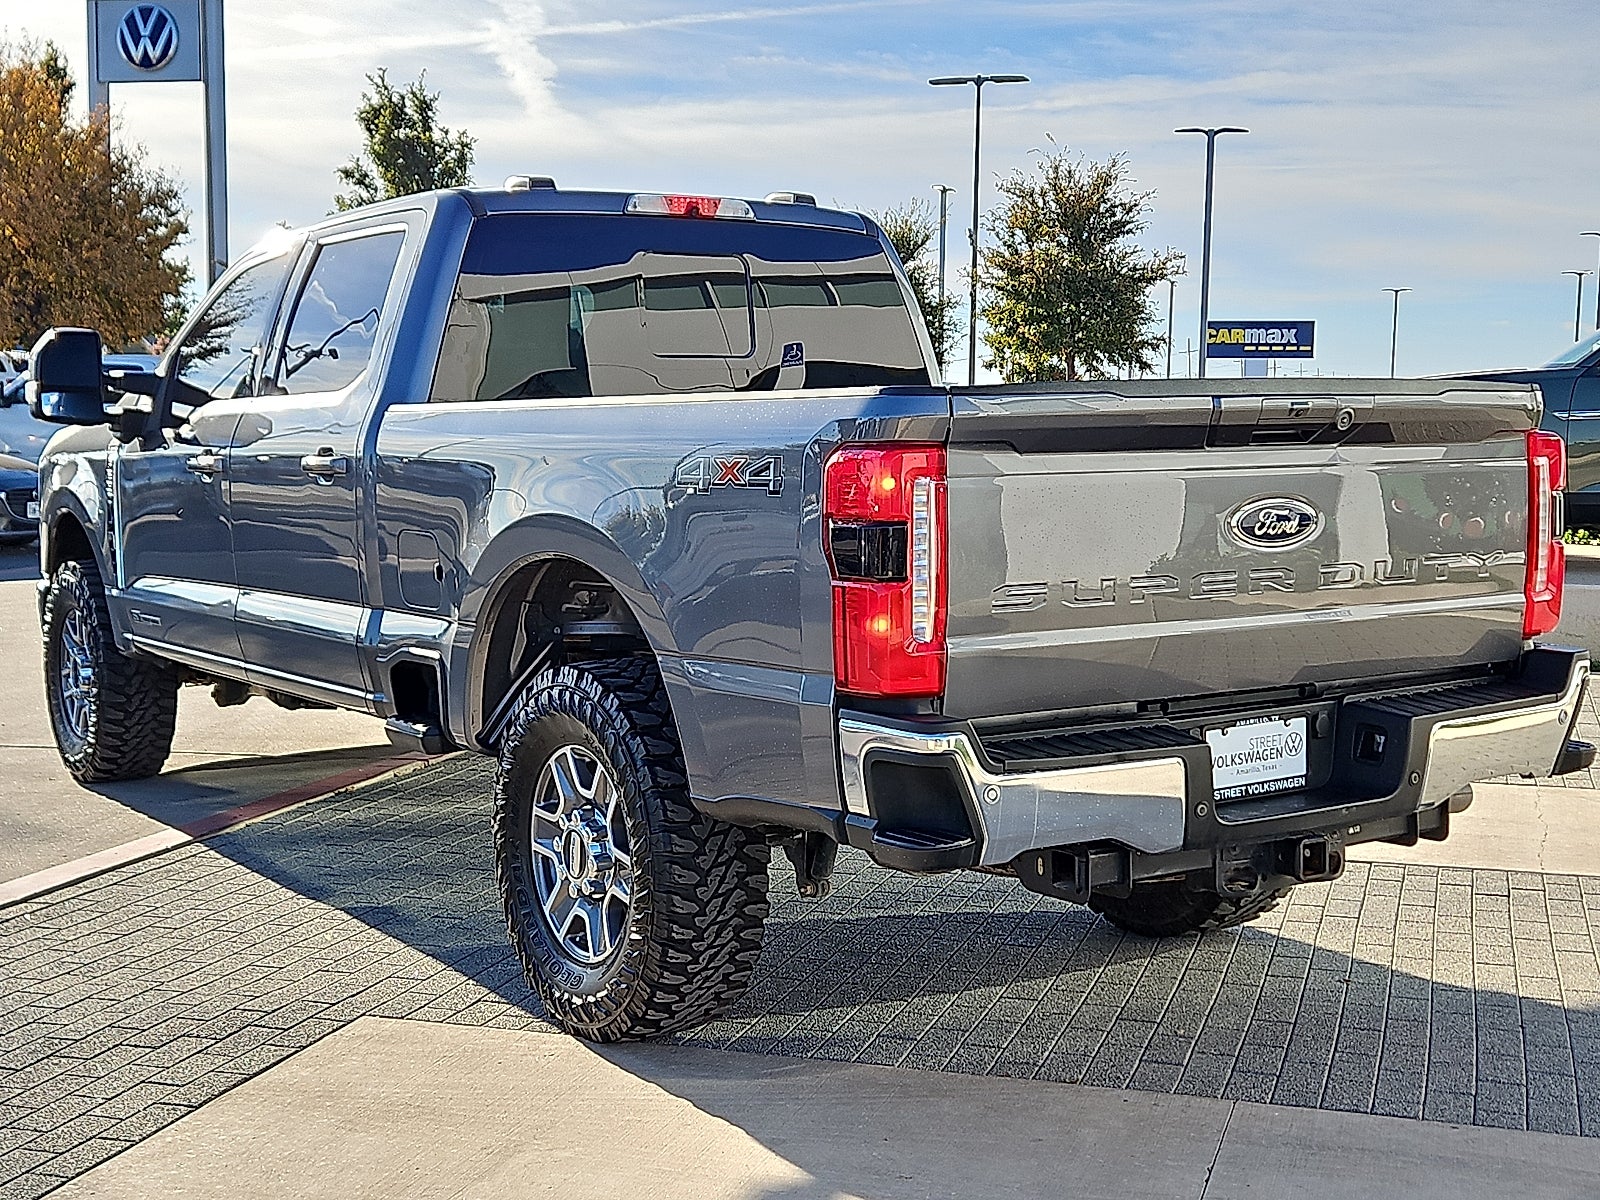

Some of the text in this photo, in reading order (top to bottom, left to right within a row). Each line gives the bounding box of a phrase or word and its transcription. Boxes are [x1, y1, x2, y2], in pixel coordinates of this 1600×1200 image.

[1254, 508, 1301, 536] Ford
[991, 550, 1504, 614] SUPER DUTY
[1249, 734, 1284, 750] STREET
[1213, 776, 1306, 800] STREET VOLKSWAGEN
